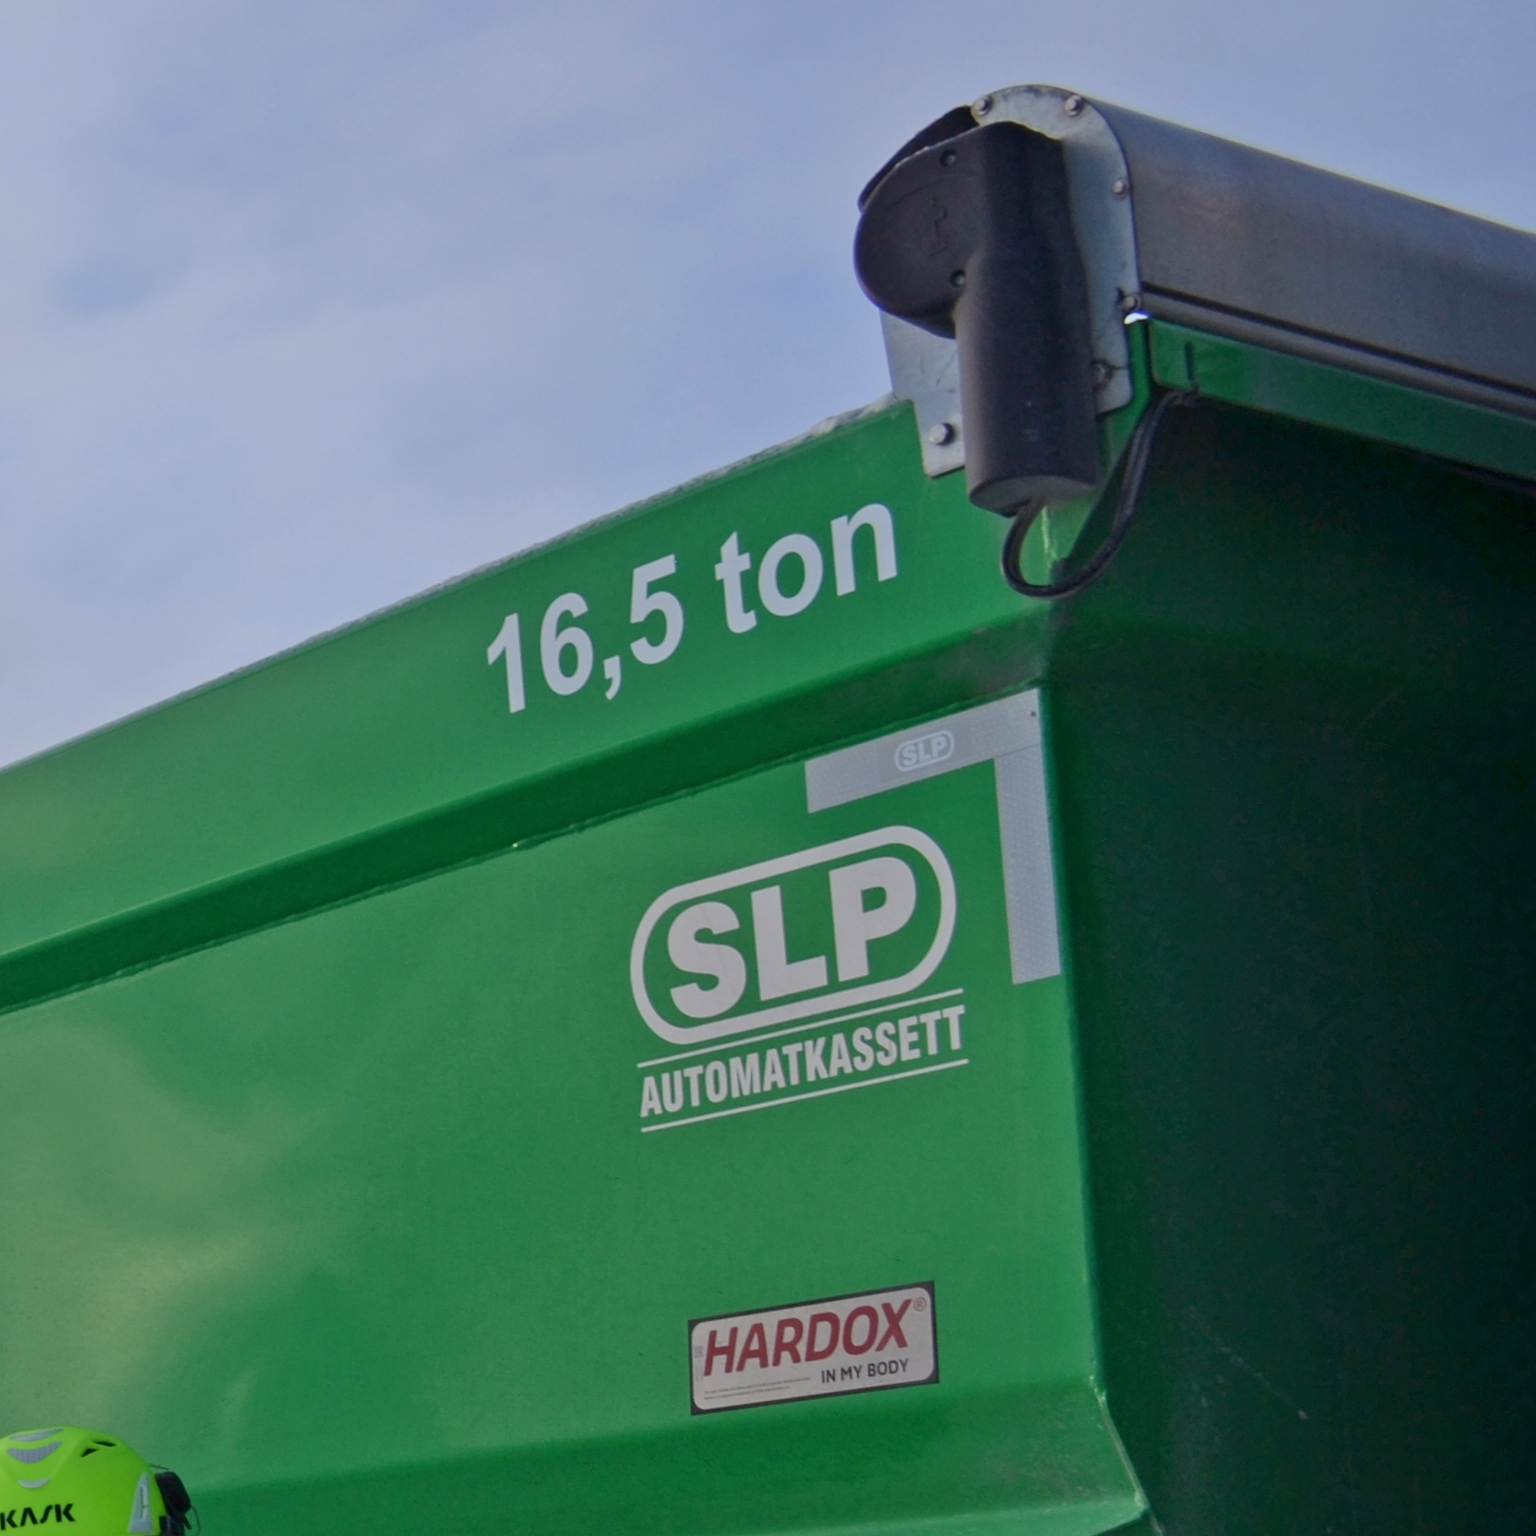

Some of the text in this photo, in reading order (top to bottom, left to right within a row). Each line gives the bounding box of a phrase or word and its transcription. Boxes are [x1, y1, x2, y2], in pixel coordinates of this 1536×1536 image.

[486, 503, 898, 714] 16,5 ton
[902, 737, 947, 766] SLP
[667, 856, 917, 1017] SLP
[640, 1004, 966, 1118] AUTOMATKASSETT
[821, 1358, 909, 1384] IN MY BODY
[0, 1503, 76, 1531] KASK
